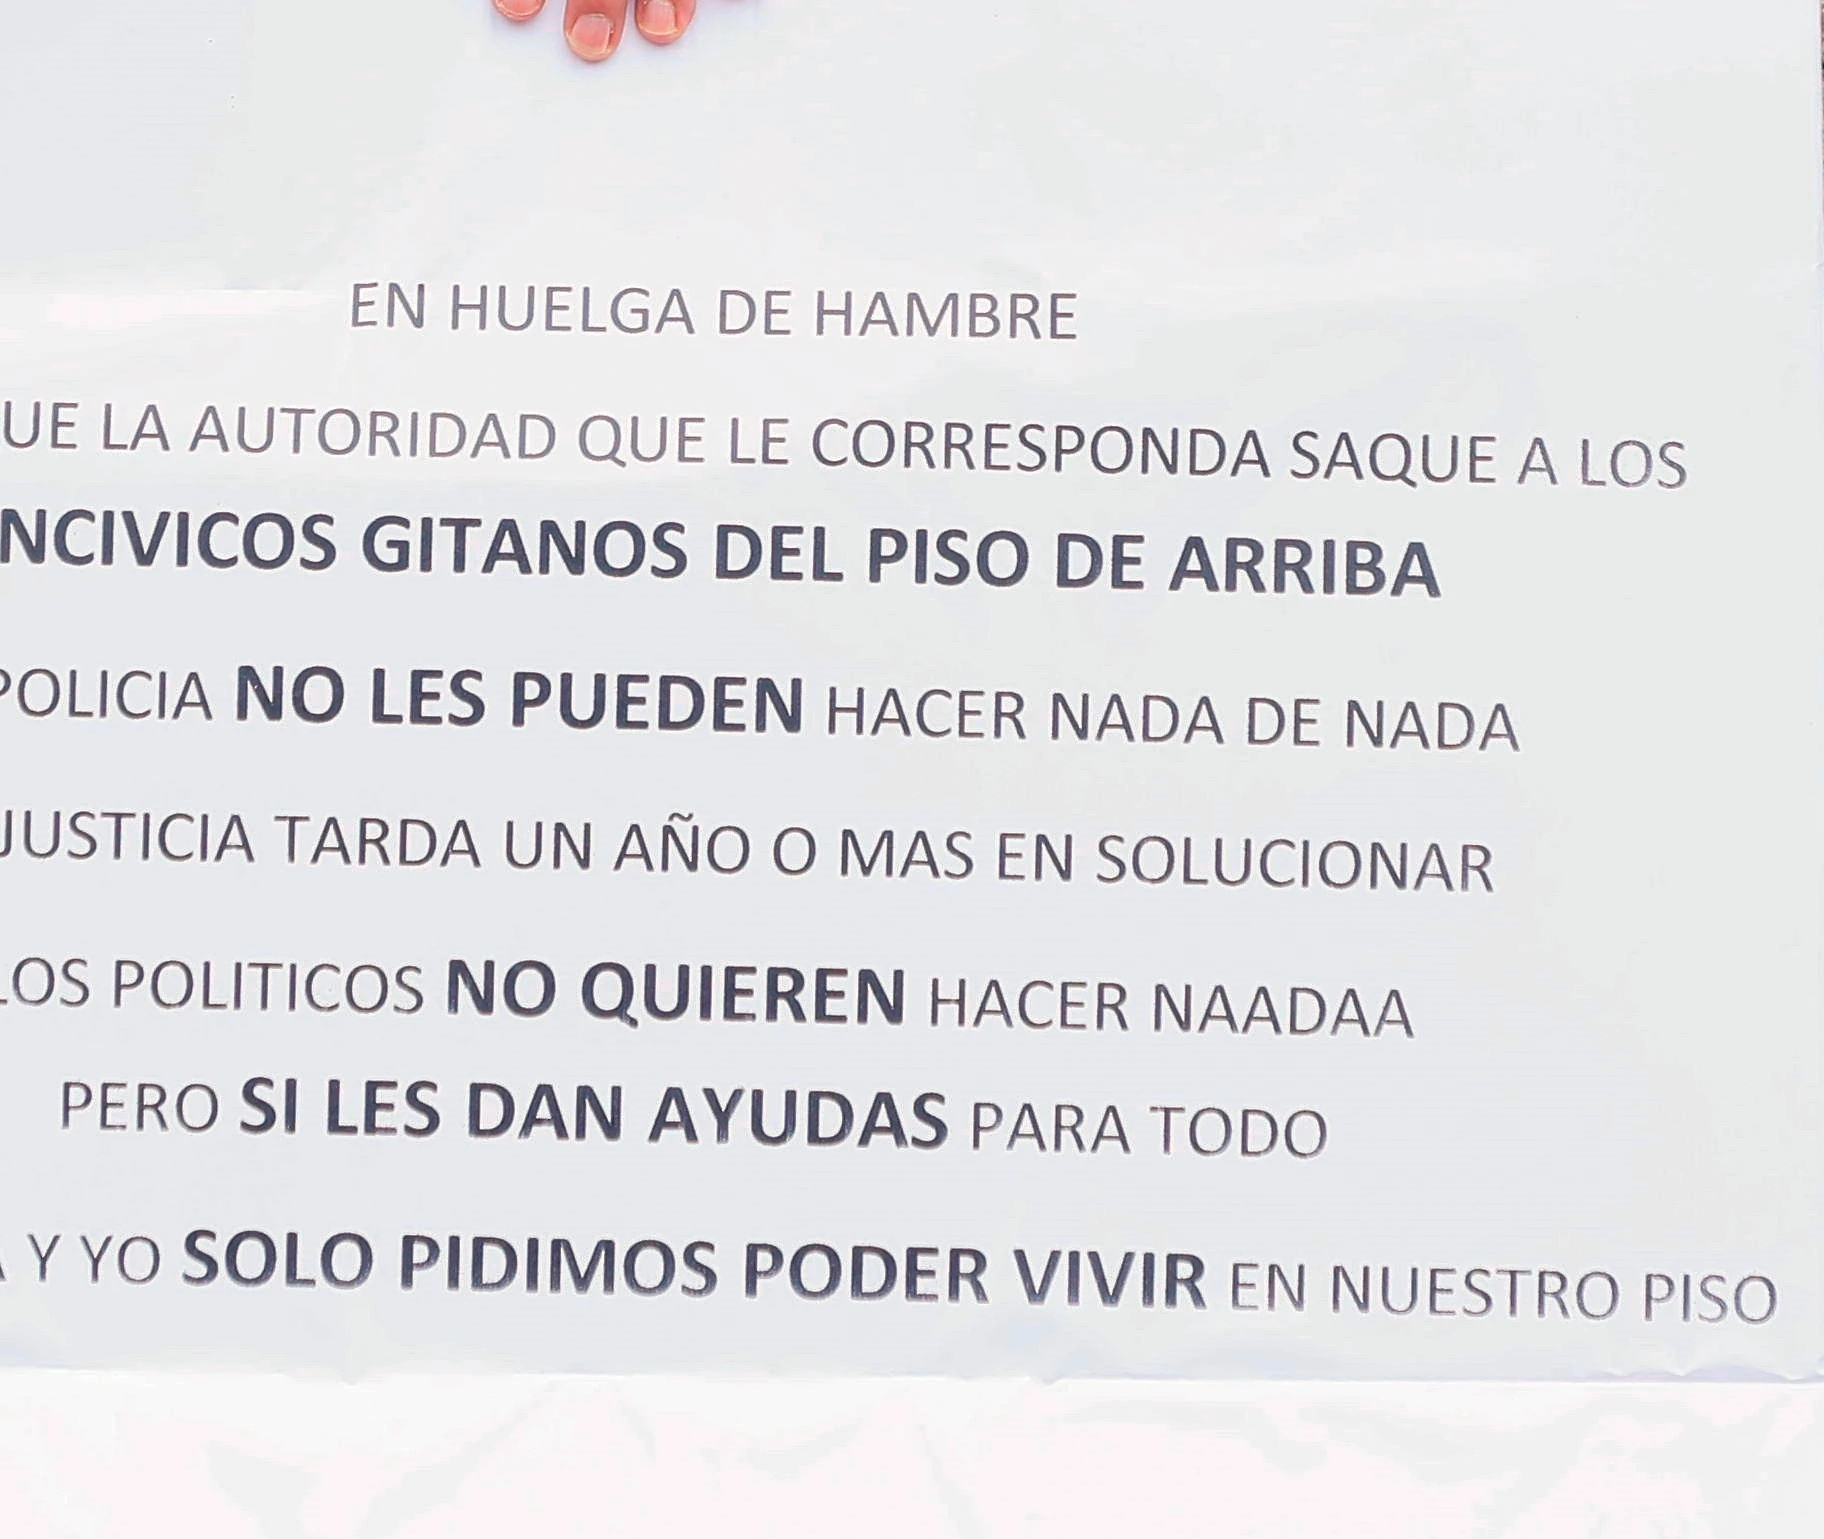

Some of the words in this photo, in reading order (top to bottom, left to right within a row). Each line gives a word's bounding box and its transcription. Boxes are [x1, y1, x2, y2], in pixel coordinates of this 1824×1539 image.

[350, 280, 427, 330] EN
[450, 282, 697, 336] HUELGA
[717, 288, 793, 337] DE
[815, 289, 1078, 341] HAMBRE
[101, 401, 172, 453] LA
[187, 404, 558, 461] AUTORIDAD
[577, 413, 707, 470] QUE
[729, 416, 791, 466] LE
[811, 416, 1272, 480] CORRESPONDA
[1289, 429, 1498, 490] SAQUE
[1515, 435, 1560, 487] A
[1579, 437, 1688, 491] LOS
[360, 513, 689, 581] GITANOS
[714, 522, 846, 584] DEL
[867, 526, 1031, 589] PISO
[1054, 531, 1146, 592] DE
[1166, 534, 1443, 600] ARRIBA
[235, 663, 346, 725] NO
[370, 666, 487, 729] LES
[510, 670, 804, 735] PUEDEN
[826, 684, 1028, 741] HACER
[1049, 690, 1226, 746] NADA
[1246, 695, 1322, 748] DE
[1345, 698, 1522, 754] NADA
[272, 814, 483, 870] TARDA
[504, 818, 593, 872] UN
[611, 810, 752, 876] AÑO
[771, 825, 818, 877] O
[839, 827, 975, 881] MAS
[997, 831, 1074, 883] EN
[1094, 833, 1495, 894] SOLUCIONAR
[112, 958, 425, 1016] POLITICOS
[446, 957, 558, 1019] NO
[579, 960, 906, 1031] QUIEREN
[929, 976, 1130, 1033] HACER
[1152, 982, 1416, 1040] NAADAA
[60, 1079, 220, 1135] PERO
[238, 1075, 299, 1137] SI
[325, 1077, 442, 1140] LES
[466, 1080, 624, 1143] DAN
[646, 1085, 950, 1152] AYUDAS
[971, 1100, 1132, 1156] PARA
[1148, 1104, 1329, 1161] TODO
[25, 1232, 63, 1284] Y
[78, 1233, 162, 1286] YO
[180, 1227, 375, 1291] SOLO
[399, 1232, 719, 1299] PIDIMOS
[743, 1241, 991, 1305] PODER
[1011, 1247, 1208, 1311] VIVIR
[1230, 1261, 1307, 1313] EN
[1330, 1263, 1621, 1322] NUESTRO
[1643, 1271, 1778, 1326] PISO
